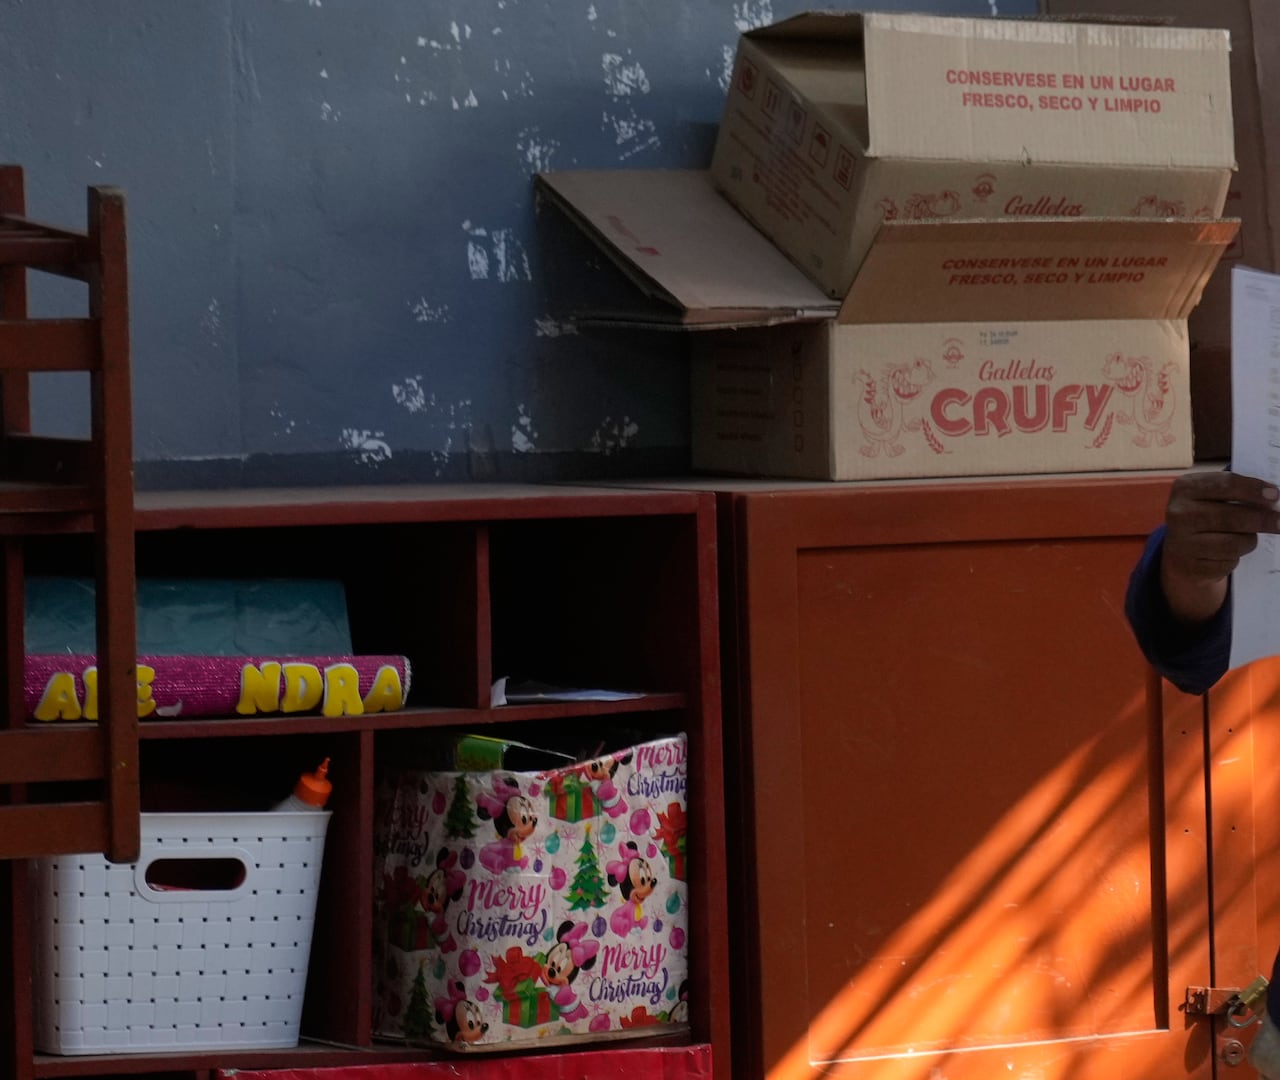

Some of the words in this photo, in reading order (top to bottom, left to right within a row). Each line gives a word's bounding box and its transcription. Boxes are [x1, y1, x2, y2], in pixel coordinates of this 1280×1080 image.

[946, 69, 1057, 89] CONSERVESE
[1062, 74, 1085, 89] EN
[1090, 75, 1114, 90] UN
[1119, 76, 1175, 92] LUGAR
[962, 92, 1034, 111] FRESCO,
[1039, 95, 1083, 110] SECO
[1087, 97, 1099, 111] Y
[1104, 98, 1161, 113] LIMPIO
[941, 256, 1053, 271] CONSERVESE
[1056, 257, 1080, 268] EN
[1084, 257, 1109, 268] UN
[1111, 256, 1169, 268] LUGAR
[948, 273, 1018, 286] FRESCO,
[1023, 273, 1069, 284] SECO
[1075, 273, 1086, 284] Y
[1087, 272, 1145, 284] LIMPIO
[930, 384, 1115, 438] CRUFY
[236, 661, 403, 717] NDRA
[627, 766, 687, 802] Christma
[468, 879, 546, 921] Merry
[457, 909, 547, 946] Christmas
[602, 943, 667, 979] Merry
[589, 968, 669, 1005] Christmas
